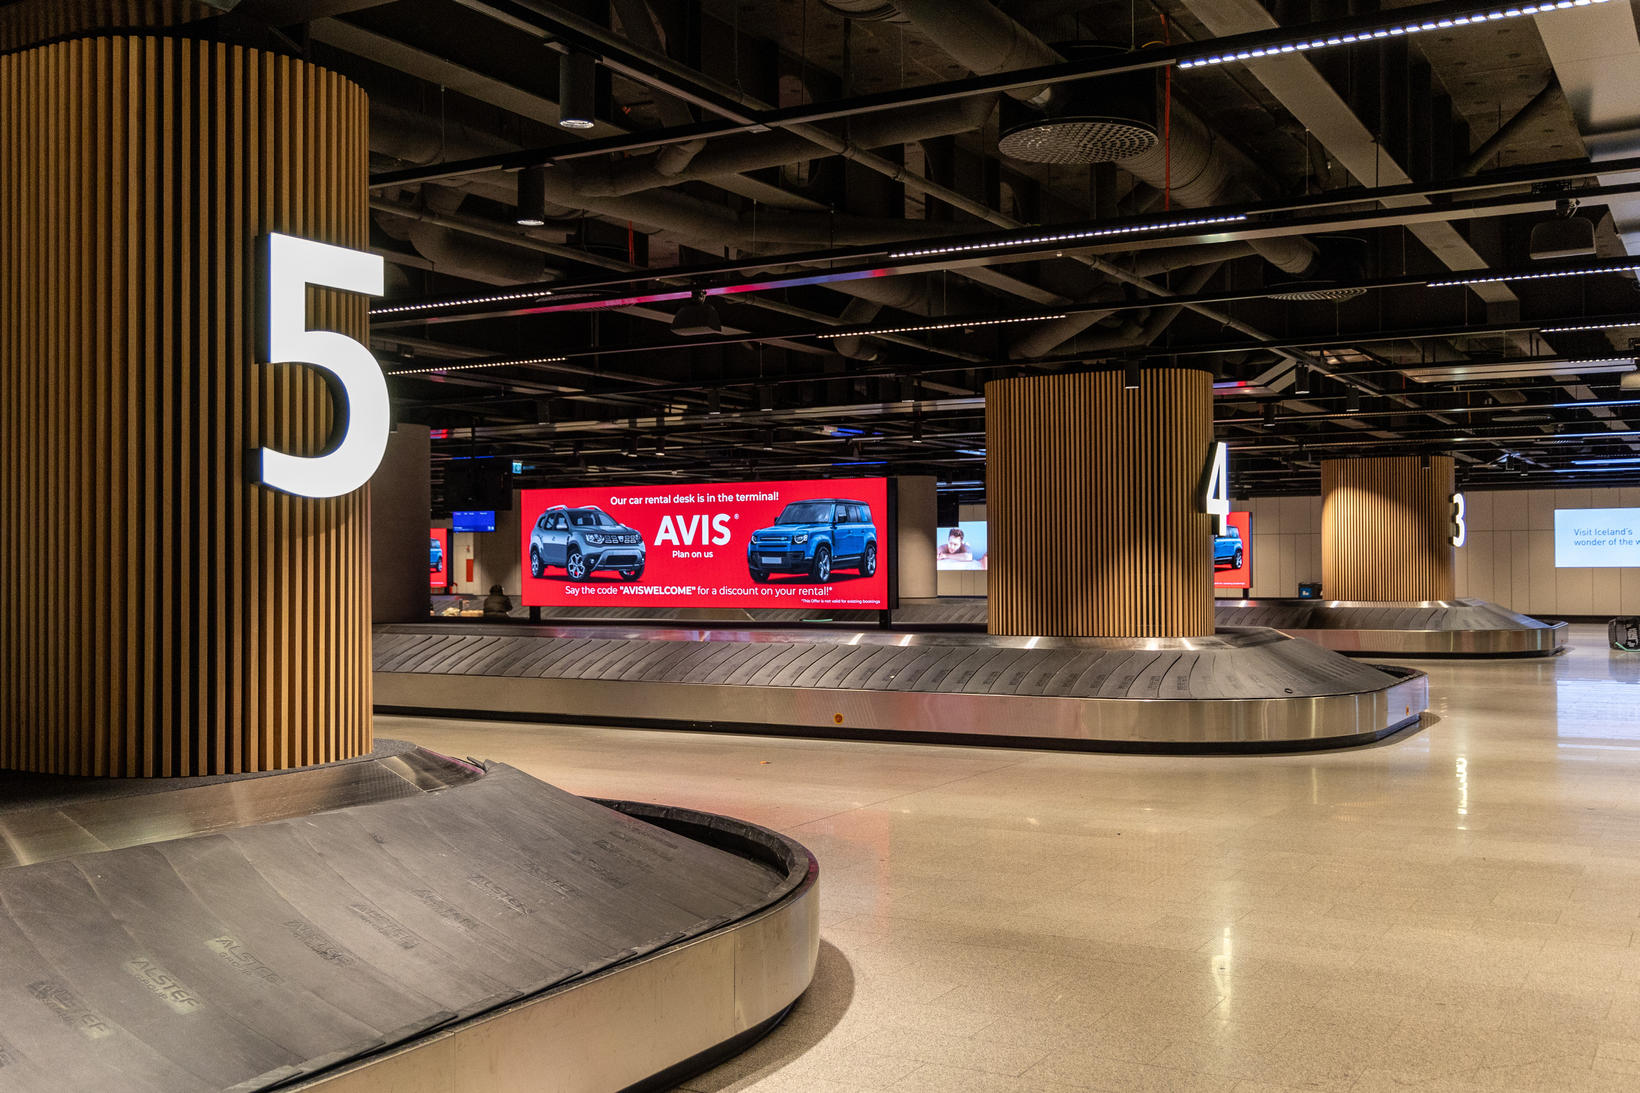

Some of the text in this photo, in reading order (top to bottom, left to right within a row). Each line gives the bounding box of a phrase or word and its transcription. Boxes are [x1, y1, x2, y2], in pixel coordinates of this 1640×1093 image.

[260, 232, 390, 498] 5
[610, 491, 779, 506] Our car rental desk is in the terminal!
[1206, 441, 1230, 536] 4
[653, 513, 731, 546] AVIS
[1452, 492, 1466, 548] 3
[1574, 528, 1592, 536] Visit
[1574, 537, 1606, 546] wonder
[1608, 537, 1617, 546] of
[1619, 538, 1633, 546] the
[672, 550, 714, 559] Plan on us
[565, 585, 580, 597] Say
[581, 585, 596, 595] the
[597, 585, 618, 595] code
[619, 585, 696, 596] "AVISWELCOME"
[697, 585, 710, 595] for
[711, 587, 717, 596] a
[719, 585, 759, 596] discount
[760, 587, 773, 596] on
[774, 587, 797, 598] your
[130, 960, 201, 1008] ALSTEF
